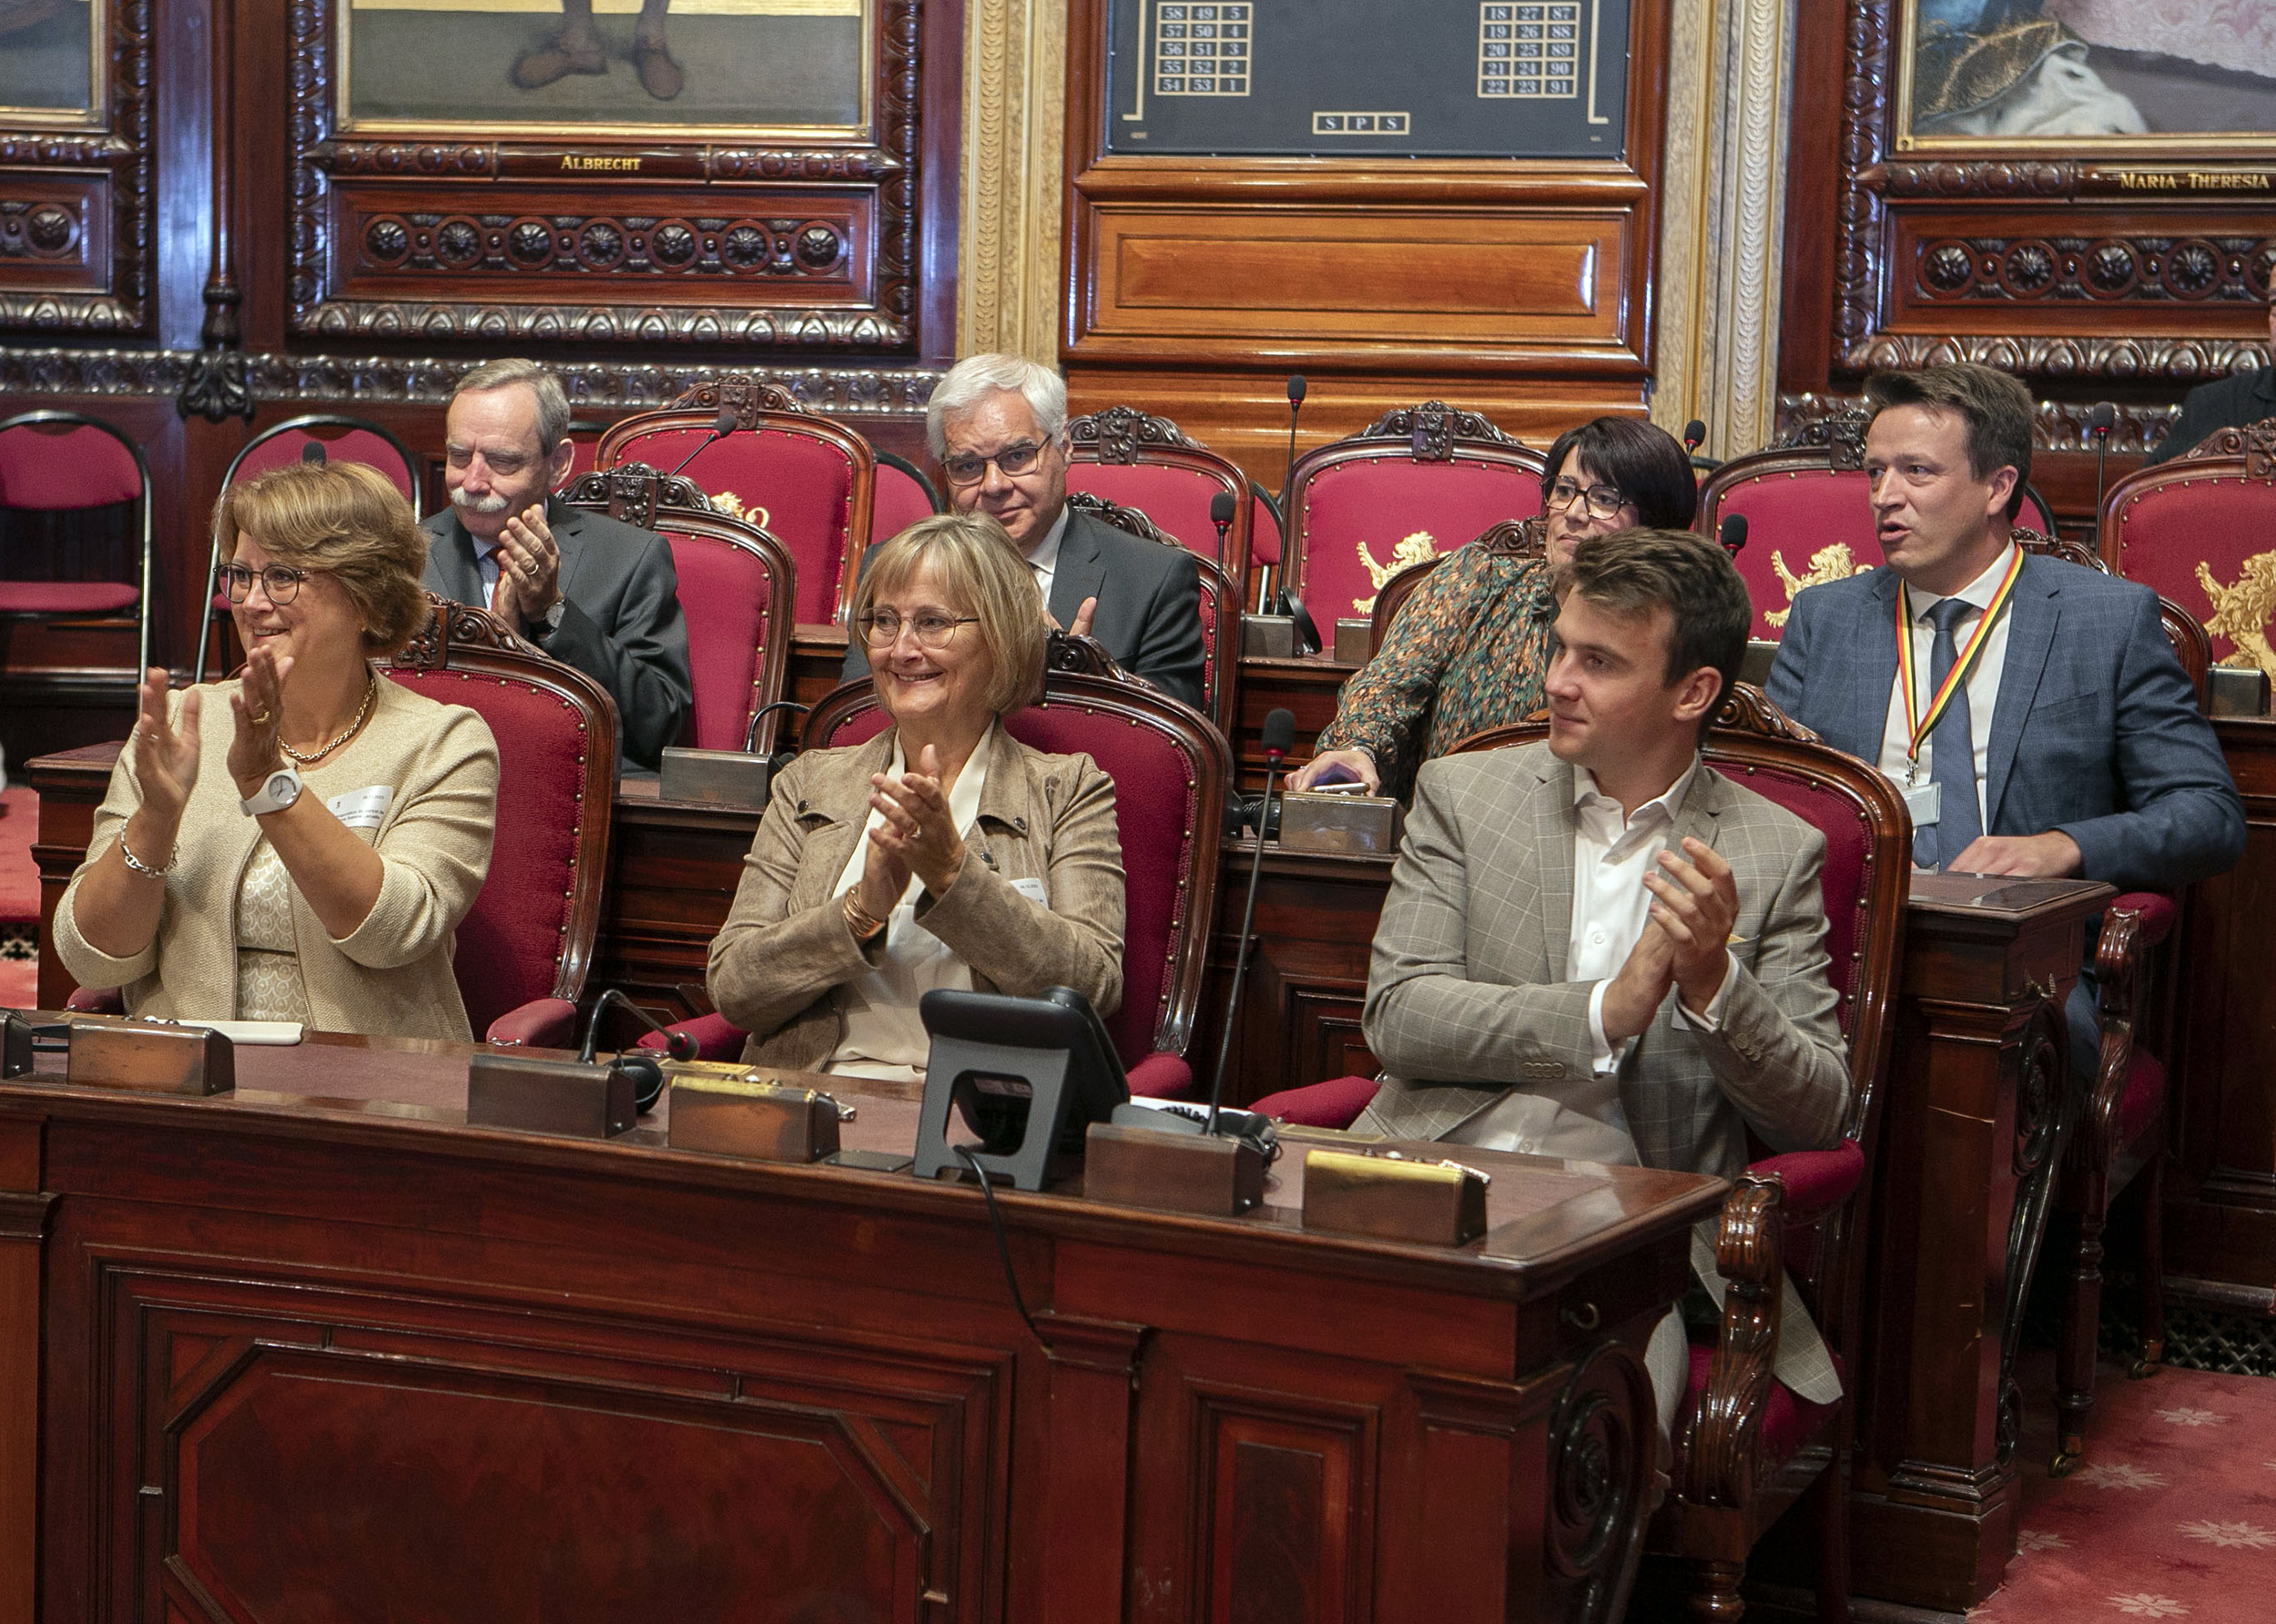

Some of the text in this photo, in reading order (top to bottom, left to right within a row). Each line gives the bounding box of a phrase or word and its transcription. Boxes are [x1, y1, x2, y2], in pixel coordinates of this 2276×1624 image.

[1165, 7, 1240, 19] 58 49 5
[1489, 6, 1571, 19] 18 27 87
[1165, 25, 1238, 37] 57 50 4
[1489, 25, 1571, 38] 19 26 88
[1164, 43, 1239, 55] 56 51 3
[1488, 44, 1570, 56] 20 25 89
[1163, 60, 1238, 74] 55 52 2
[1488, 62, 1570, 75] 21 24 90
[1163, 78, 1236, 92] 54 53 1
[1487, 80, 1568, 94] 22 23 91
[1326, 117, 1397, 130] S P S
[561, 155, 642, 170] ALBRECHT
[2120, 172, 2270, 188] MARIA THERESIA
